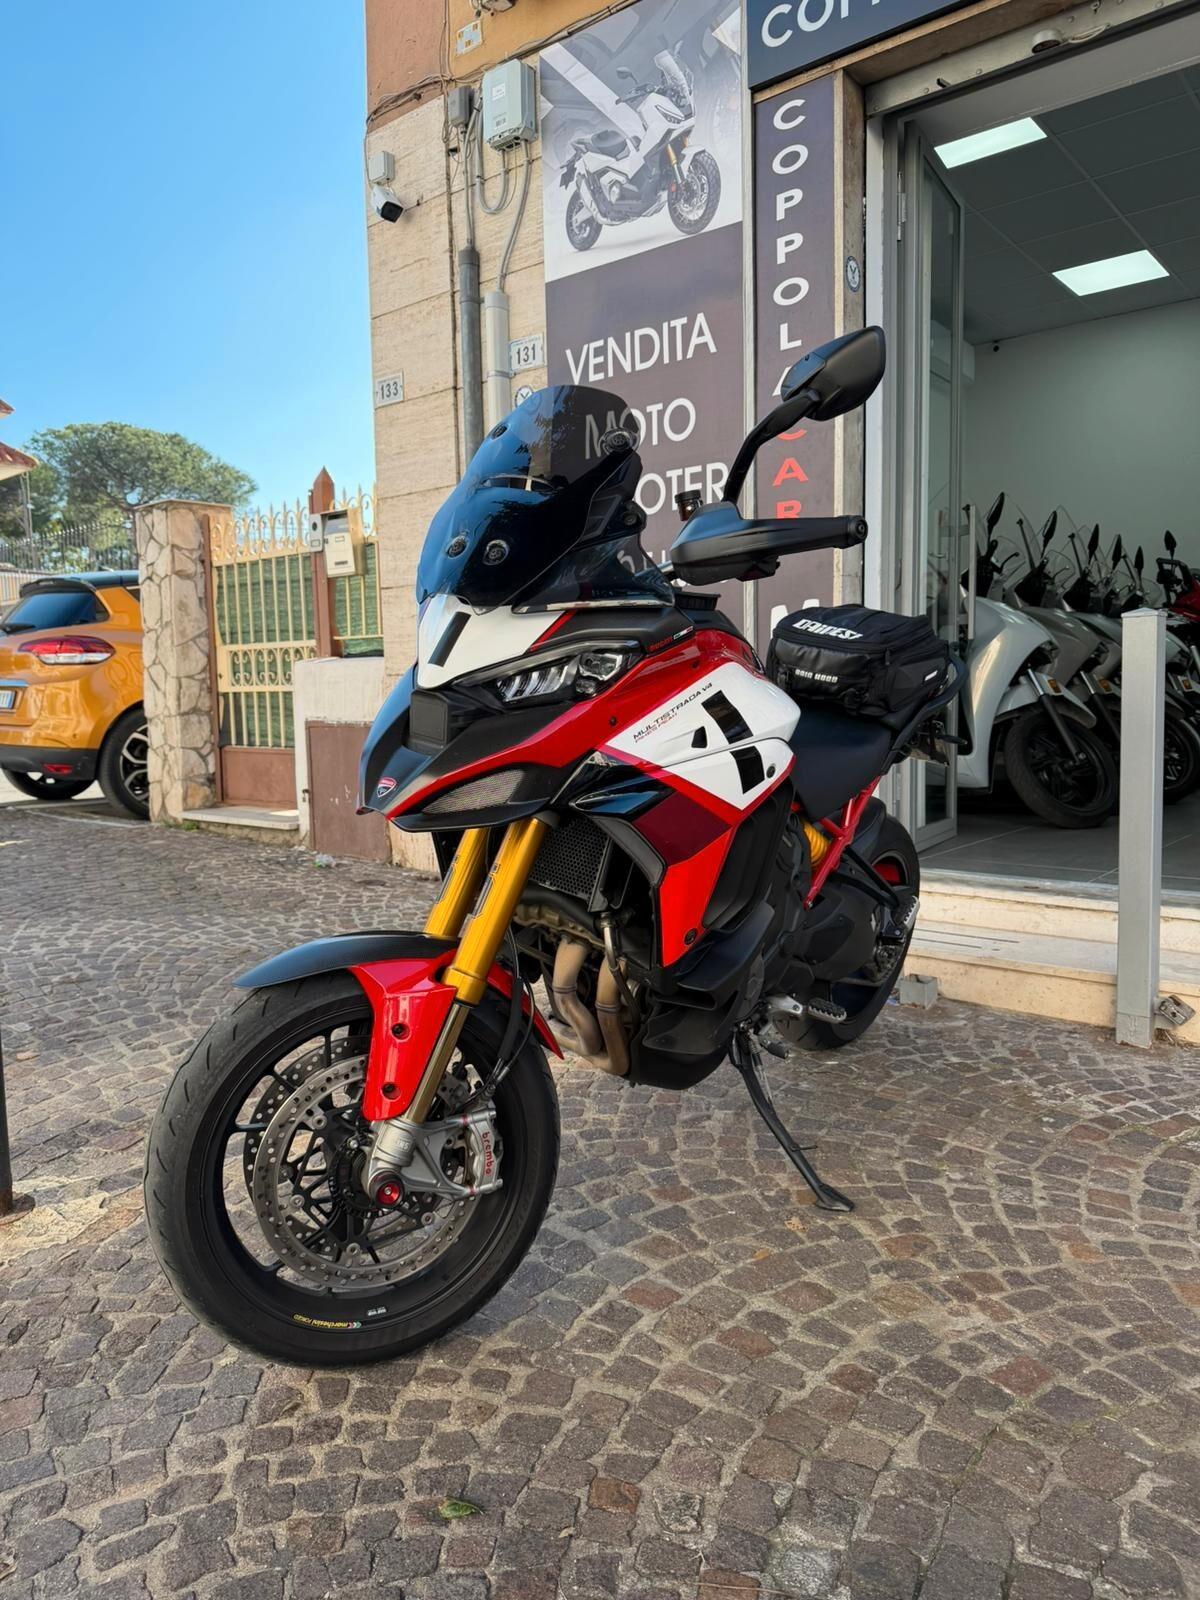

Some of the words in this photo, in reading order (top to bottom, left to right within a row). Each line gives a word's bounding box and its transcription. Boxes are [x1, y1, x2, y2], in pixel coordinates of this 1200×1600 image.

[516, 343, 536, 365] 131
[565, 312, 717, 385] VENDITA
[380, 381, 399, 400] 133
[584, 397, 697, 460] MOTO
[633, 690, 702, 740] MULTISTRADA
[482, 1131, 495, 1175] brembo
